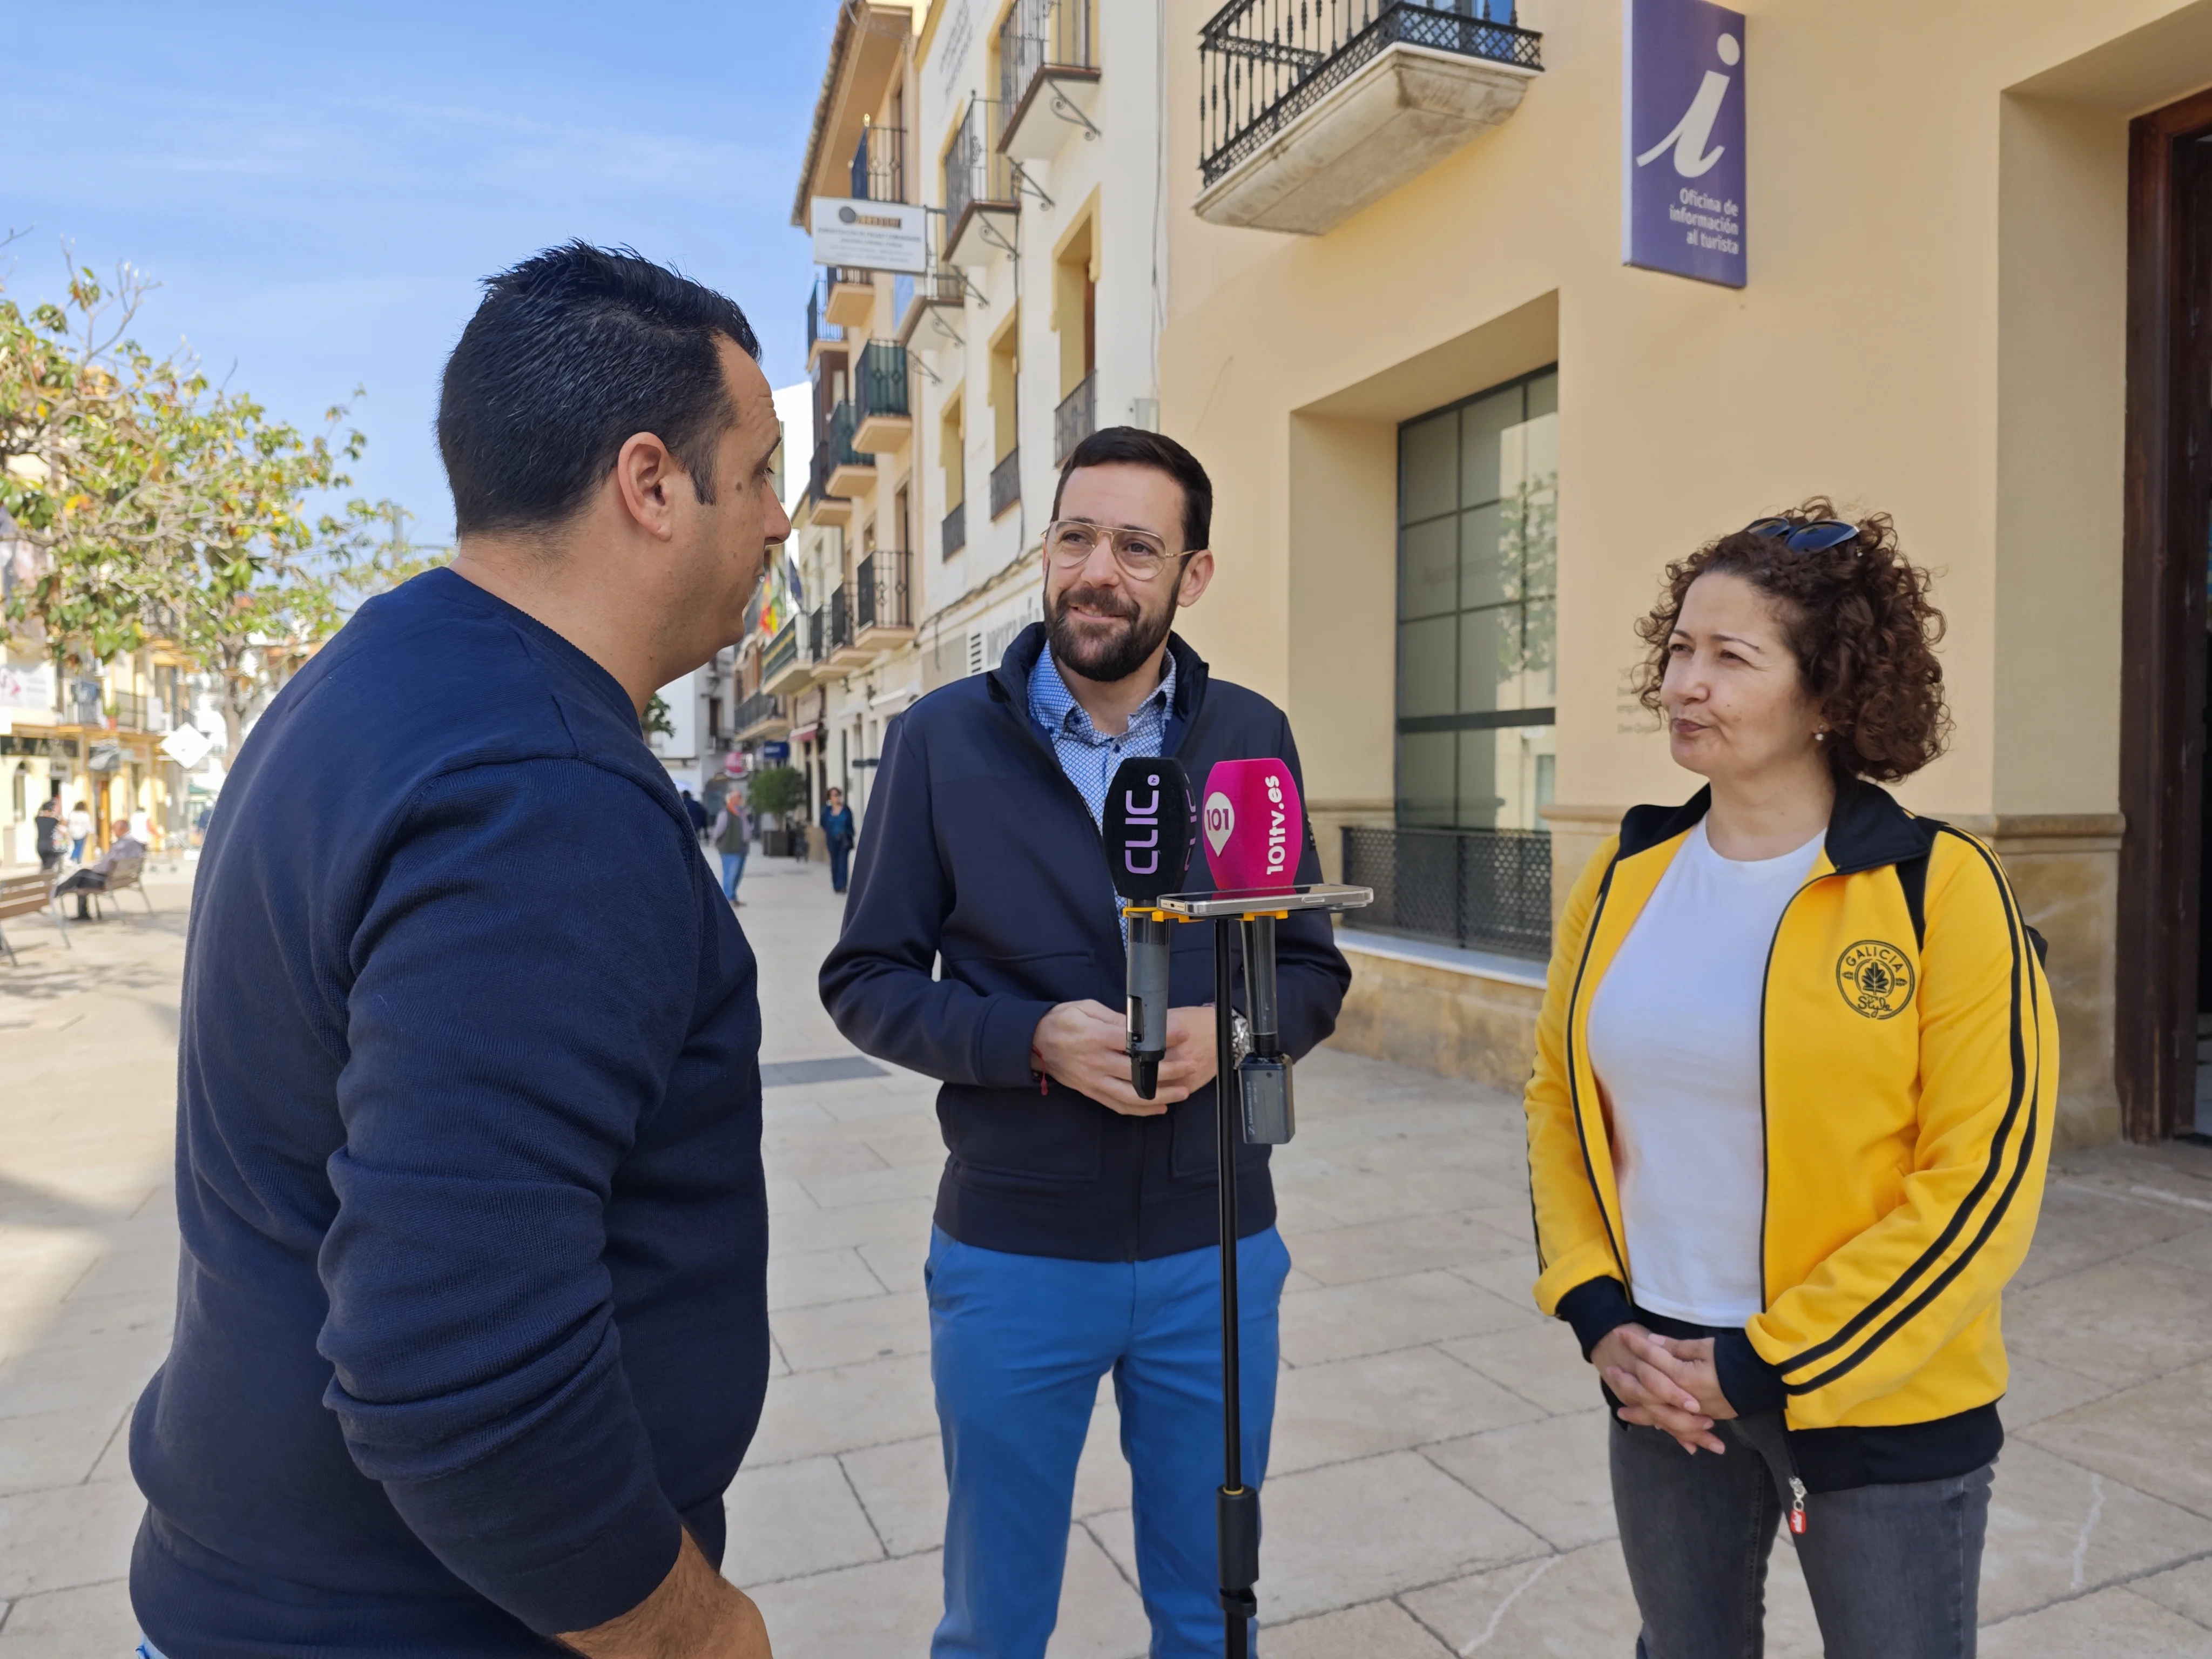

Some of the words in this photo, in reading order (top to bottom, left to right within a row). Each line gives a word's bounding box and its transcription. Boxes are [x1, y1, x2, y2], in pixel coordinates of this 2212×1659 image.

[1680, 187, 1721, 213] Oficina
[1723, 199, 1738, 217] de
[1669, 203, 1739, 235] información
[1686, 228, 1698, 246] al
[1700, 232, 1739, 254] turista
[1125, 790, 1159, 874] CLIC
[1206, 808, 1230, 831] 101
[1265, 775, 1285, 875] 101tv.es
[1845, 946, 1904, 973] GALICIA
[1857, 994, 1893, 1019] Style
